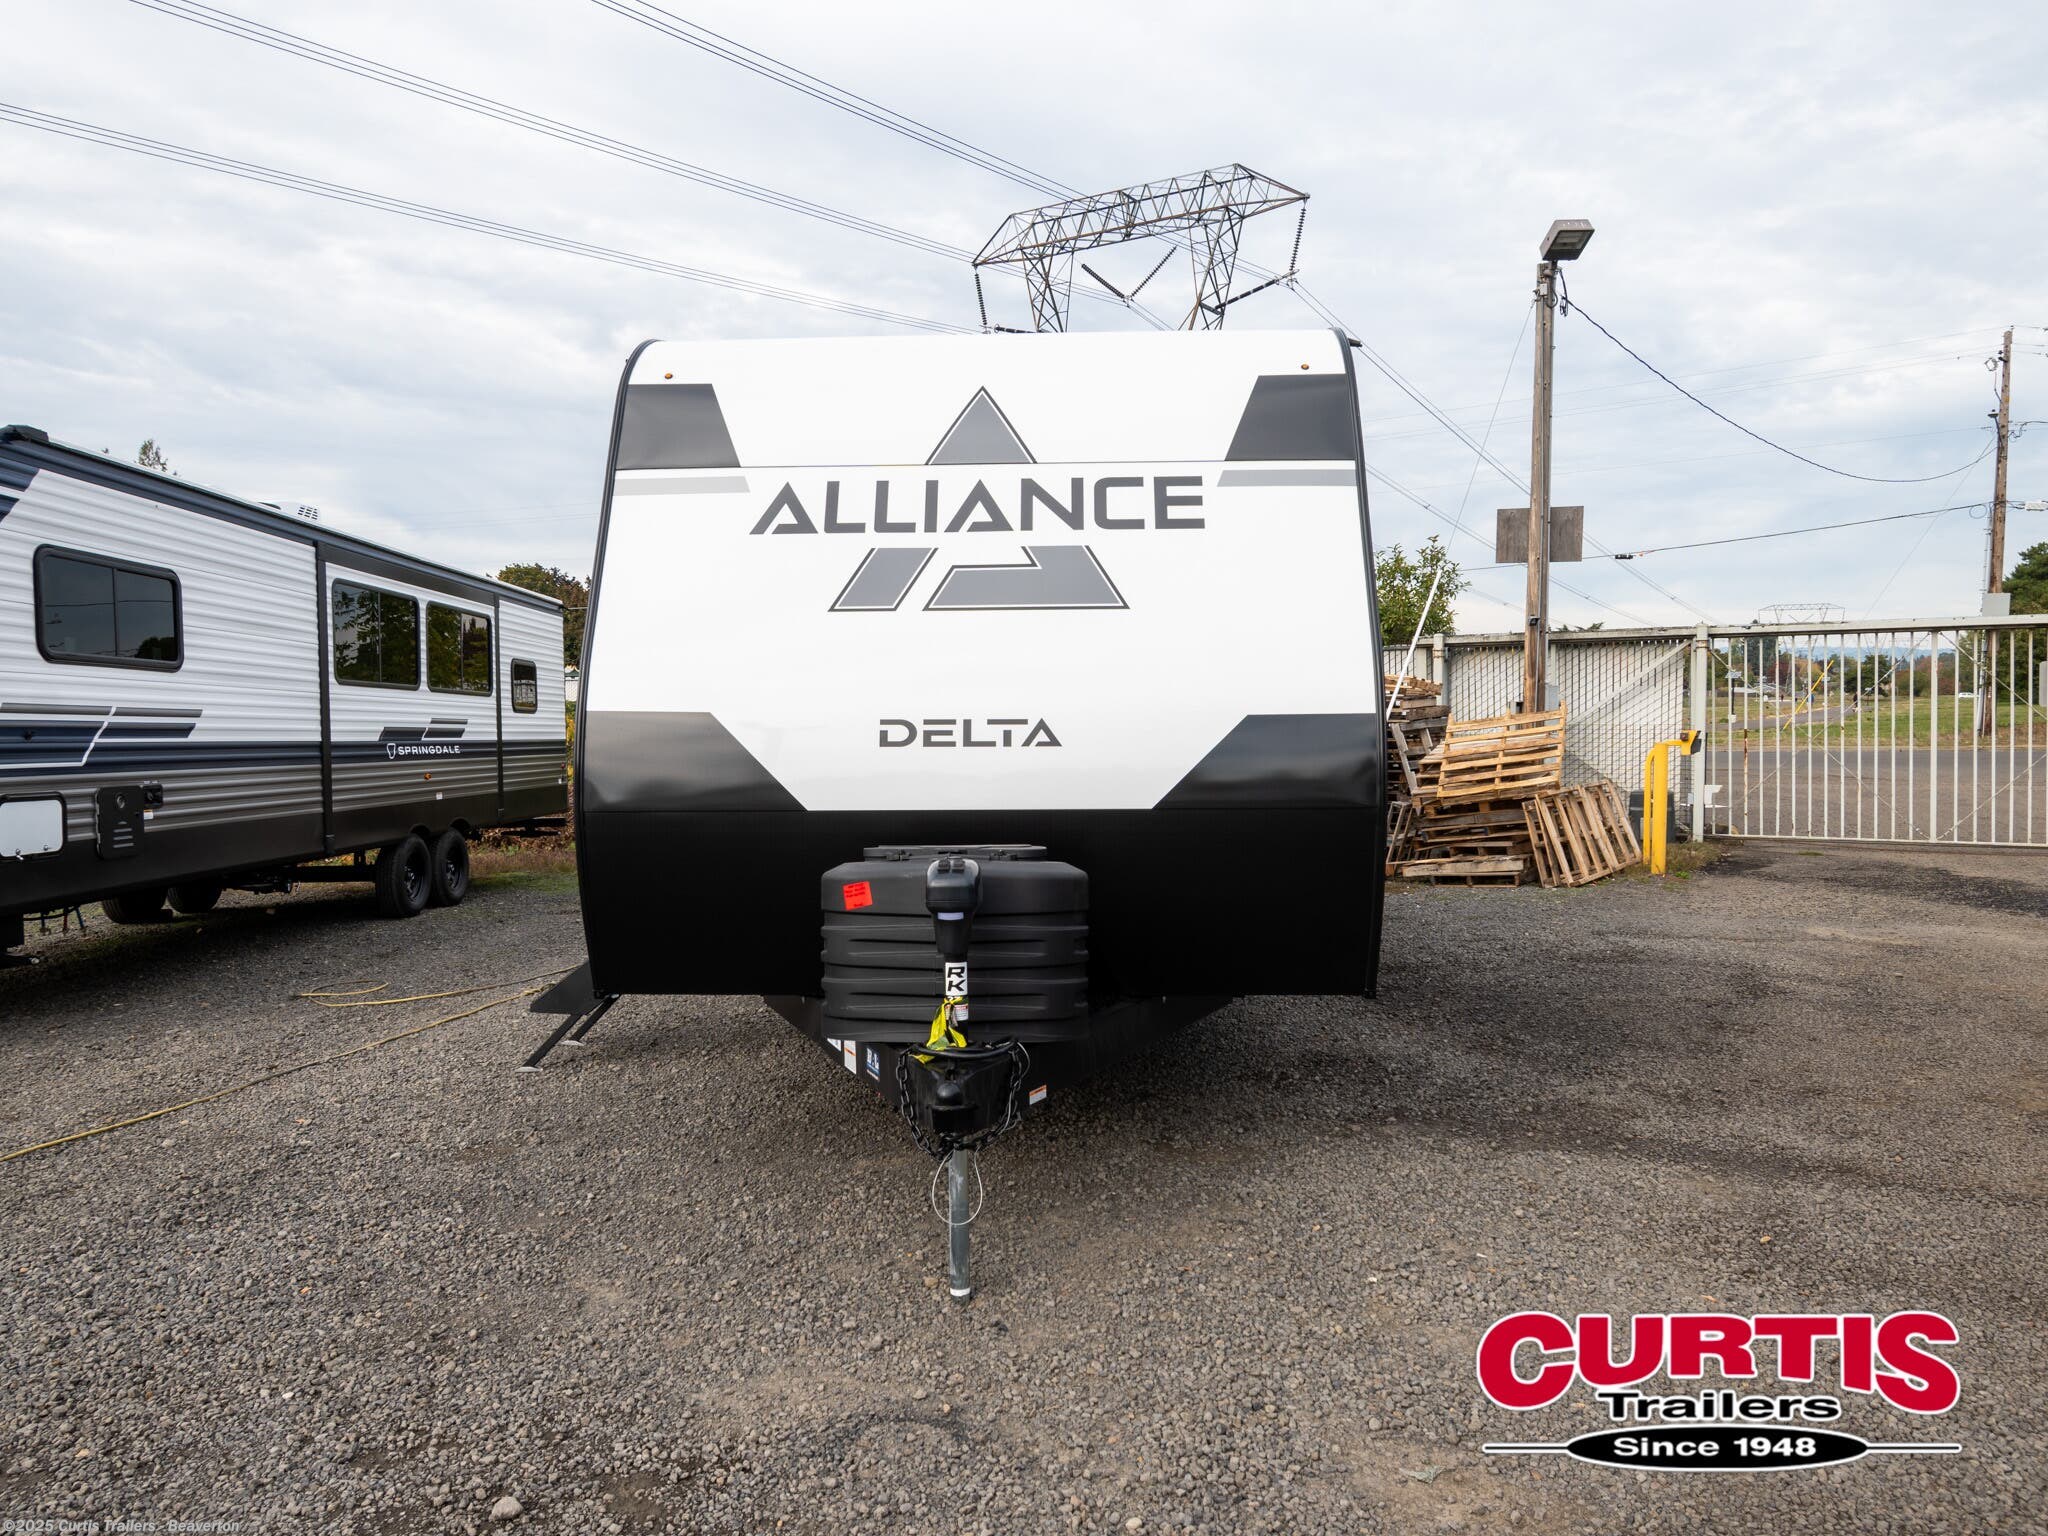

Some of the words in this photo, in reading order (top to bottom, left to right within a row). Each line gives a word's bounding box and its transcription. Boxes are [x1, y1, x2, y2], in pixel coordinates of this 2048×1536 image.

[748, 475, 1206, 535] ALLIANCE
[879, 717, 1063, 748] DELTA
[397, 745, 461, 756] SPRINGDALE
